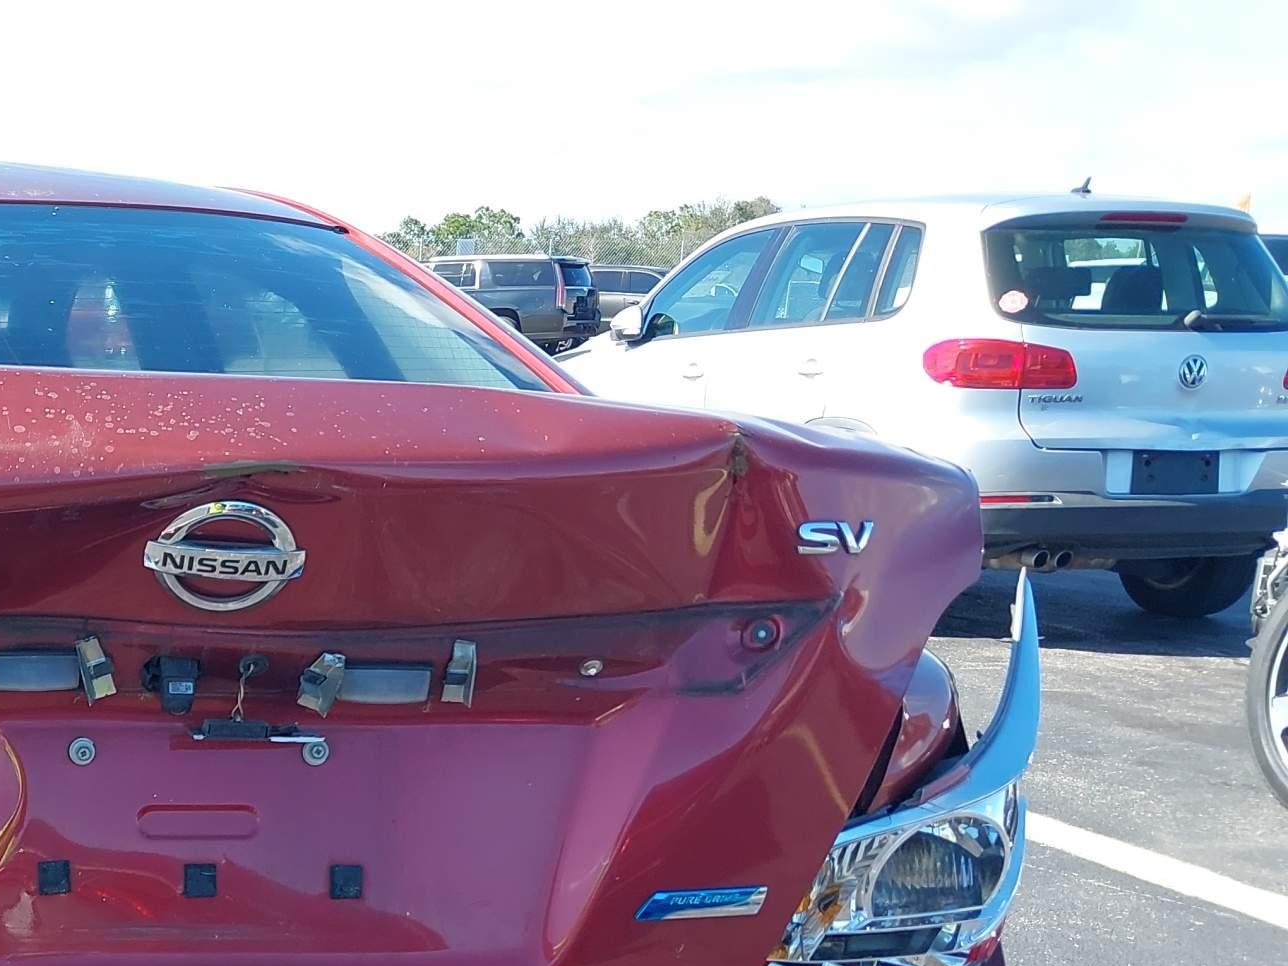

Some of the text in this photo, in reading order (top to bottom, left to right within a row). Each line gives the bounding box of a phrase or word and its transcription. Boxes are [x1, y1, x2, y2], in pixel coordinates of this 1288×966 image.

[1027, 394, 1084, 404] TIGUAN
[797, 520, 874, 555] SV
[162, 552, 288, 576] NISSAN
